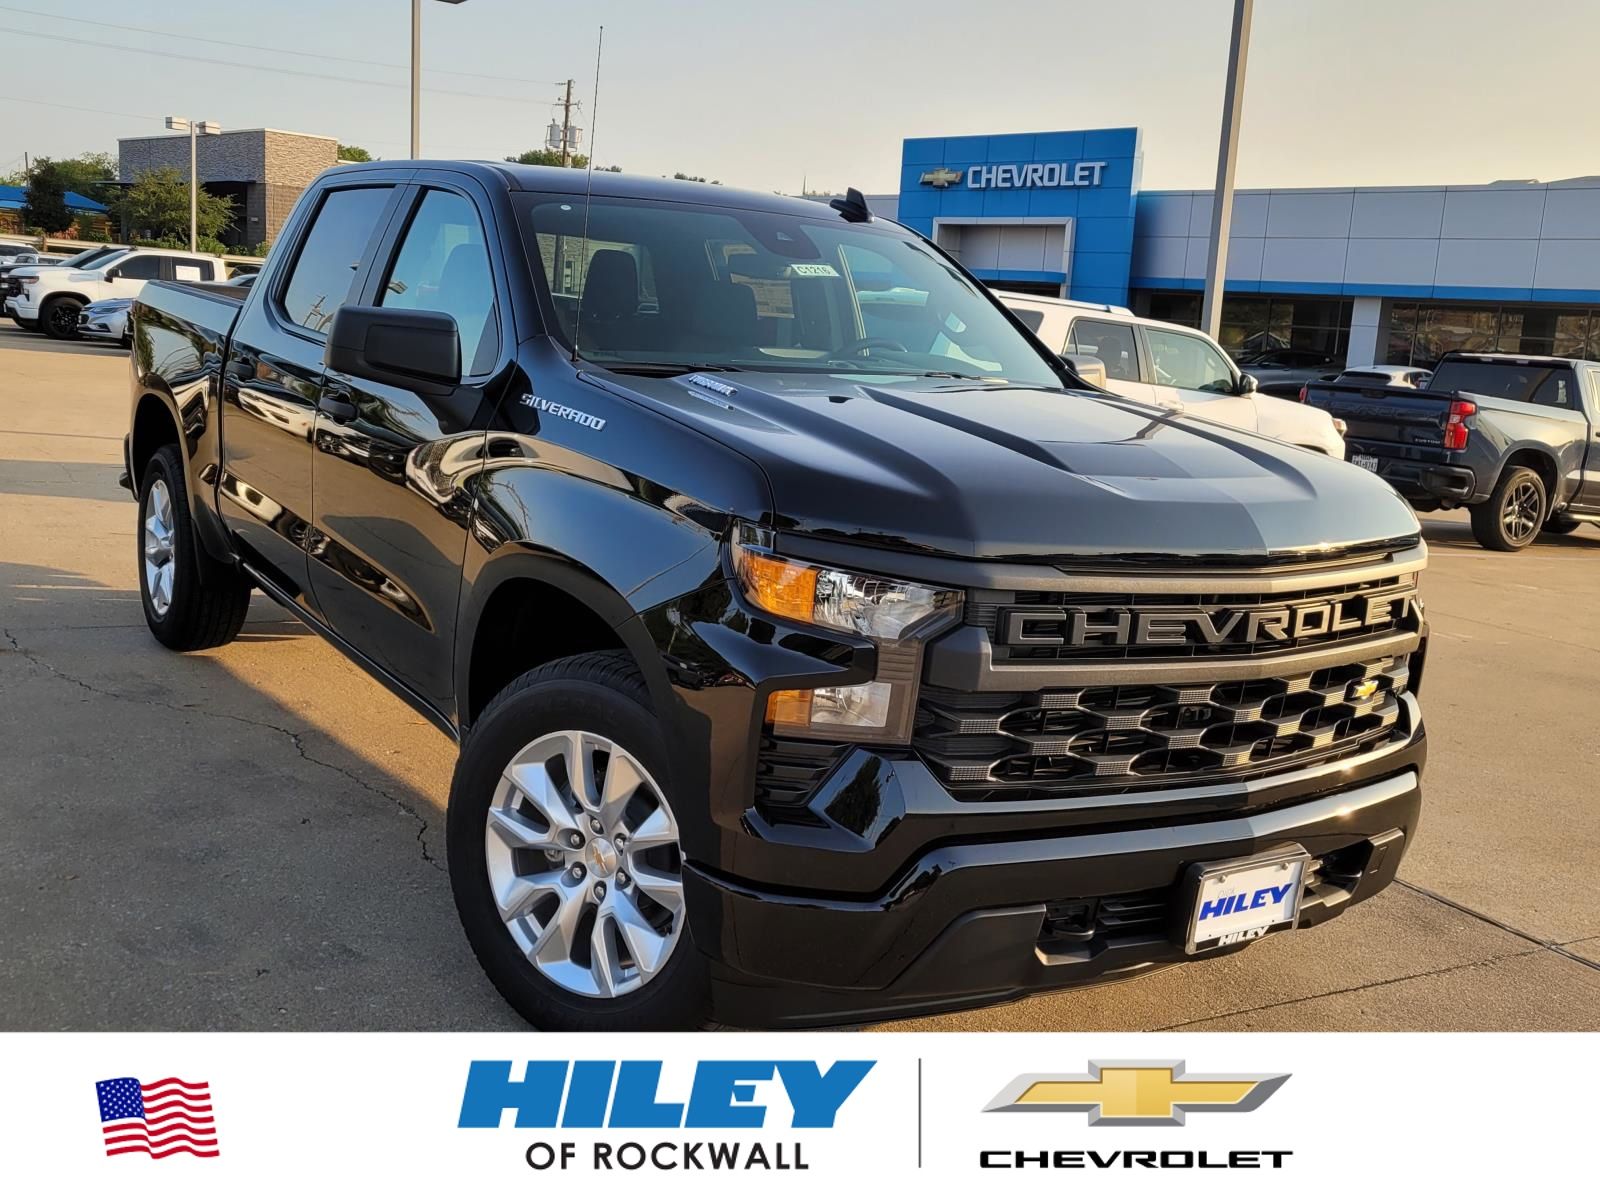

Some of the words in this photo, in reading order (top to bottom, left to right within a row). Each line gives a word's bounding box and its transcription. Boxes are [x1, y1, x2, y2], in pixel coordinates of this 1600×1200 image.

[967, 161, 1108, 188] CHEVROLET
[519, 393, 607, 431] SILVERADO
[1003, 592, 1417, 646] CHEVROLET
[1199, 883, 1293, 921] HILEY
[1218, 925, 1270, 946] HILEY
